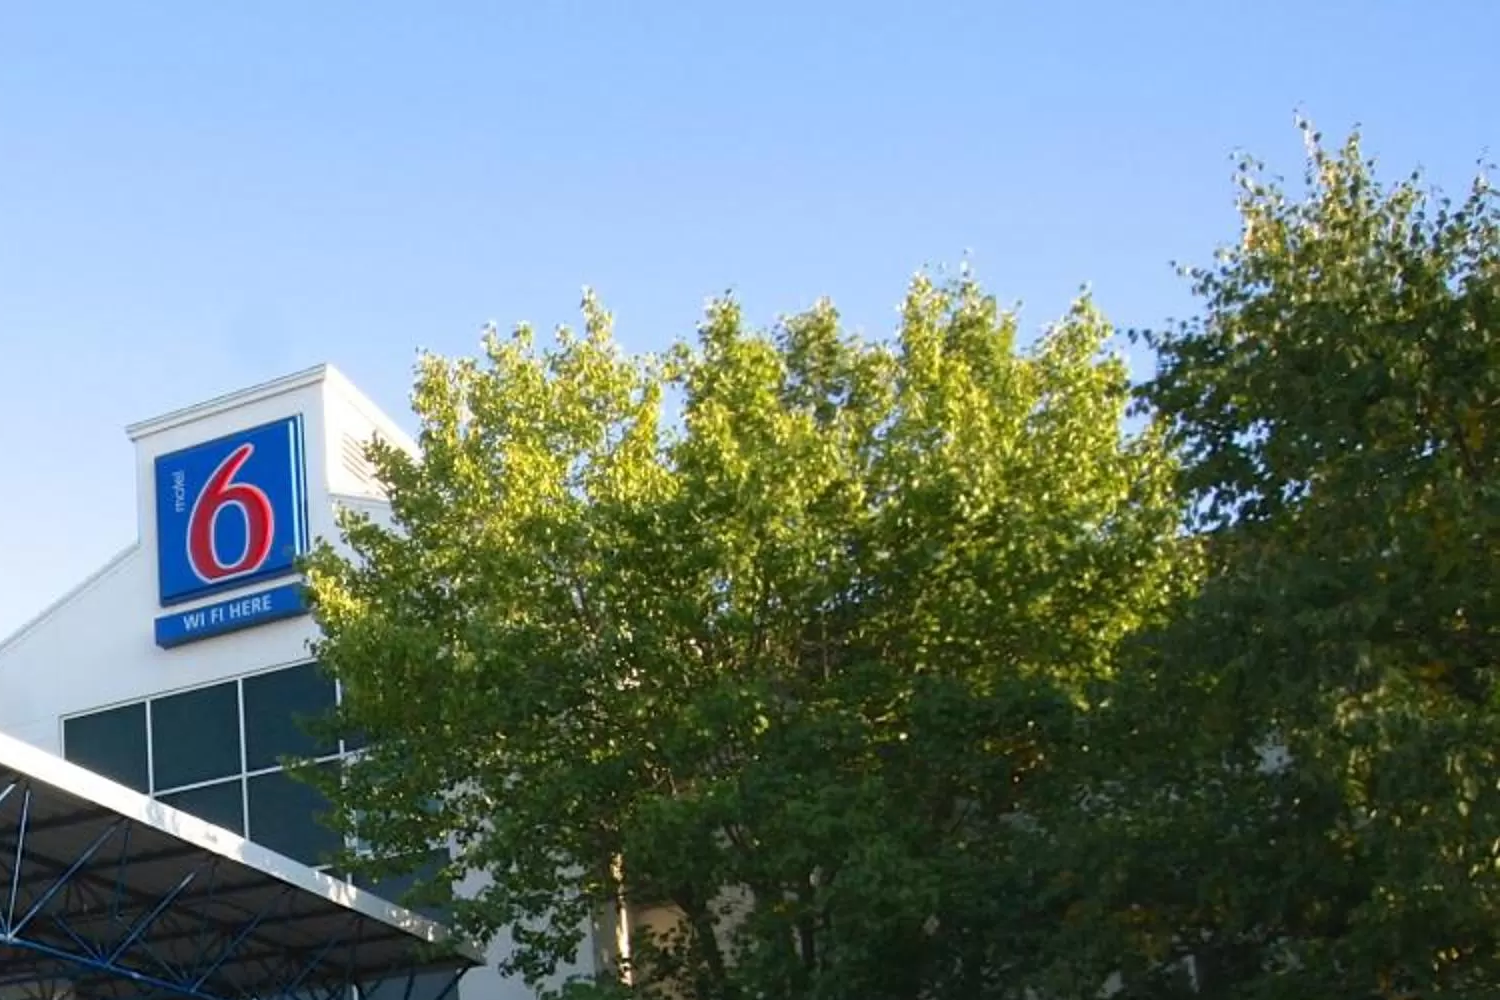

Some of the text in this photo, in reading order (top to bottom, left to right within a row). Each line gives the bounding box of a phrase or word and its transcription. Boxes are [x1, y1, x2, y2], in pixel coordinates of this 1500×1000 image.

[186, 443, 275, 584] 6
[183, 594, 272, 631] WI FI HERE
